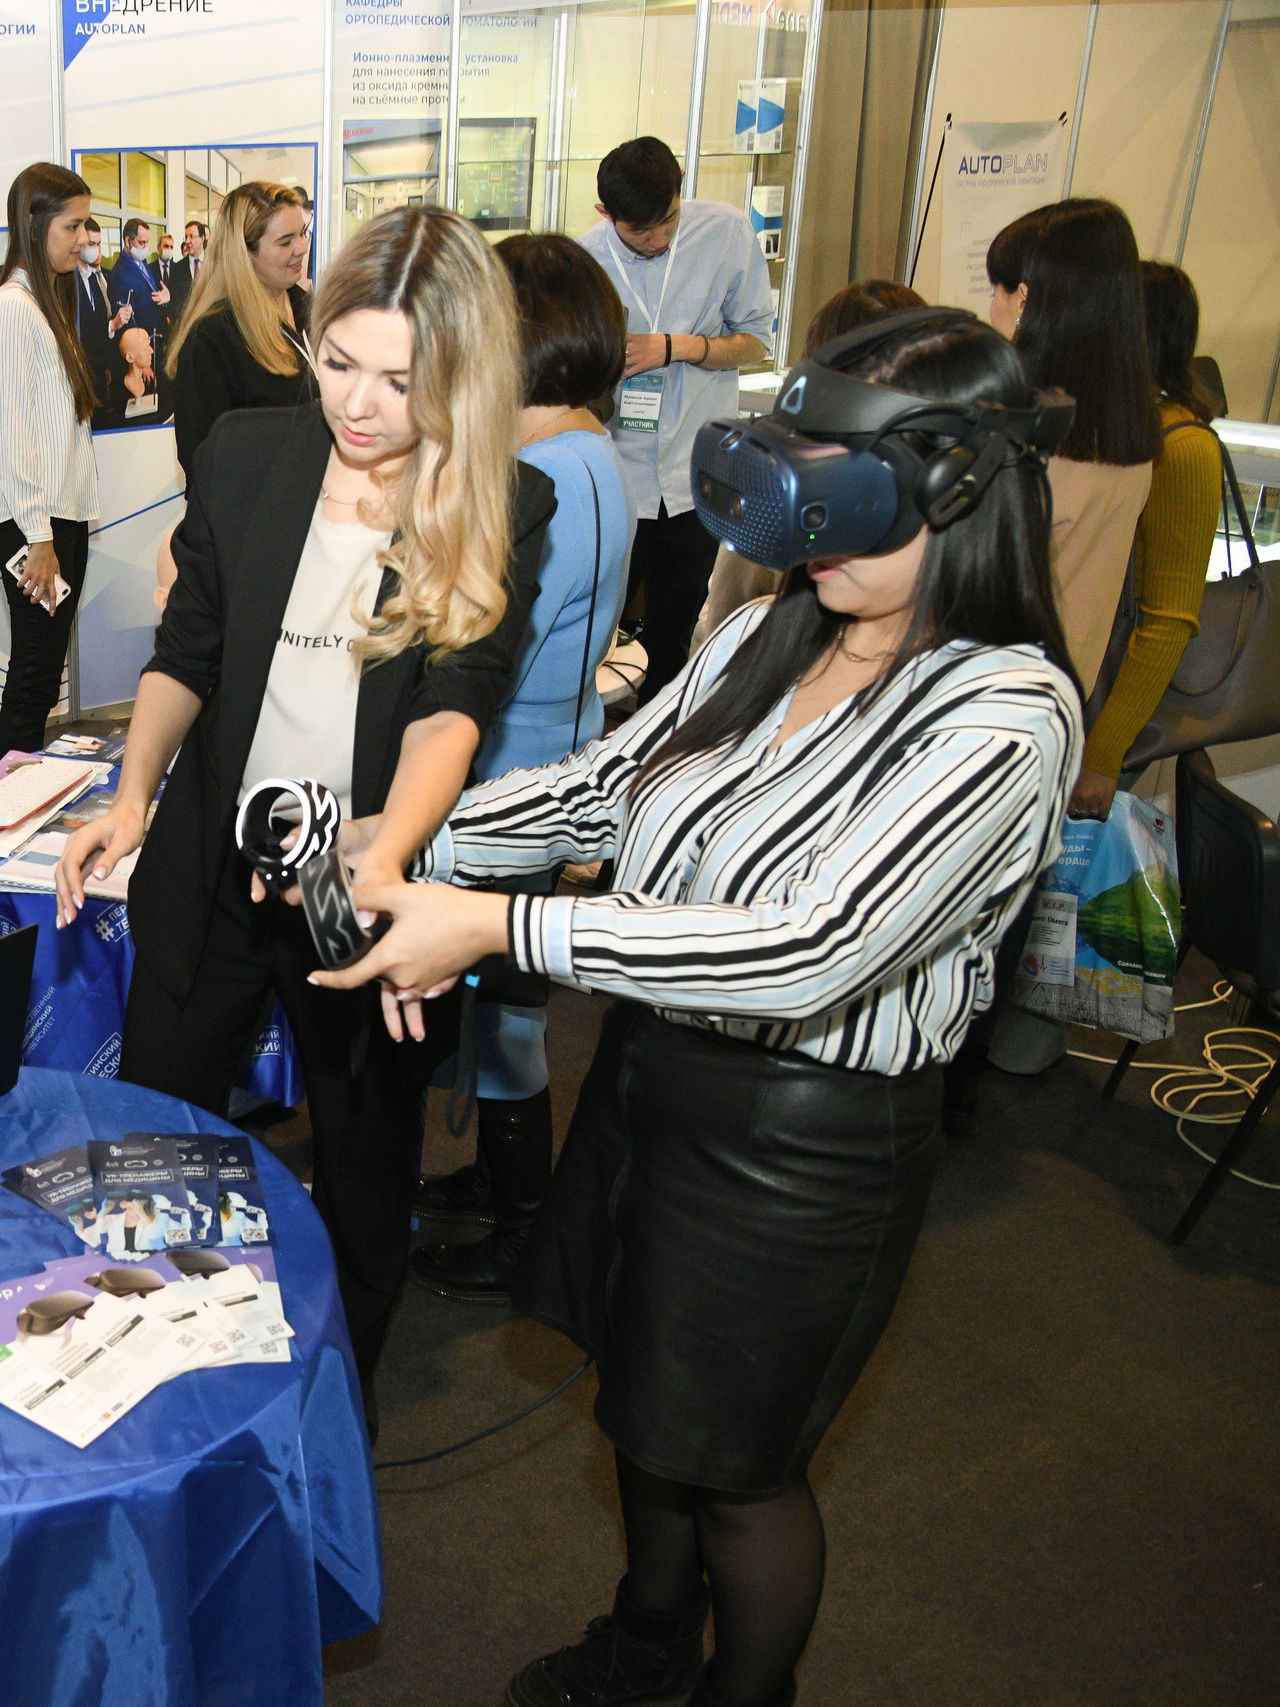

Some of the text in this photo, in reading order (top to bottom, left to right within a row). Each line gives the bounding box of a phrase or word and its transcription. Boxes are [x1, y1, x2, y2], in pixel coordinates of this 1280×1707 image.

[345, 13, 538, 28] ОРТОПЕДИЧЕСКОЙ ТОМАТОЛОИИ
[74, 22, 146, 35] AUTOPLAN
[465, 55, 518, 65] установка
[352, 67, 373, 78] для
[376, 67, 436, 77] нанесения
[352, 82, 366, 92] из
[369, 81, 408, 93] оксида
[352, 96, 366, 105] на
[369, 94, 418, 105] съёмные
[958, 153, 1048, 175] AUTOPLAN
[622, 420, 655, 429] УЧАСТНИК
[1058, 857, 1091, 867] ердце
